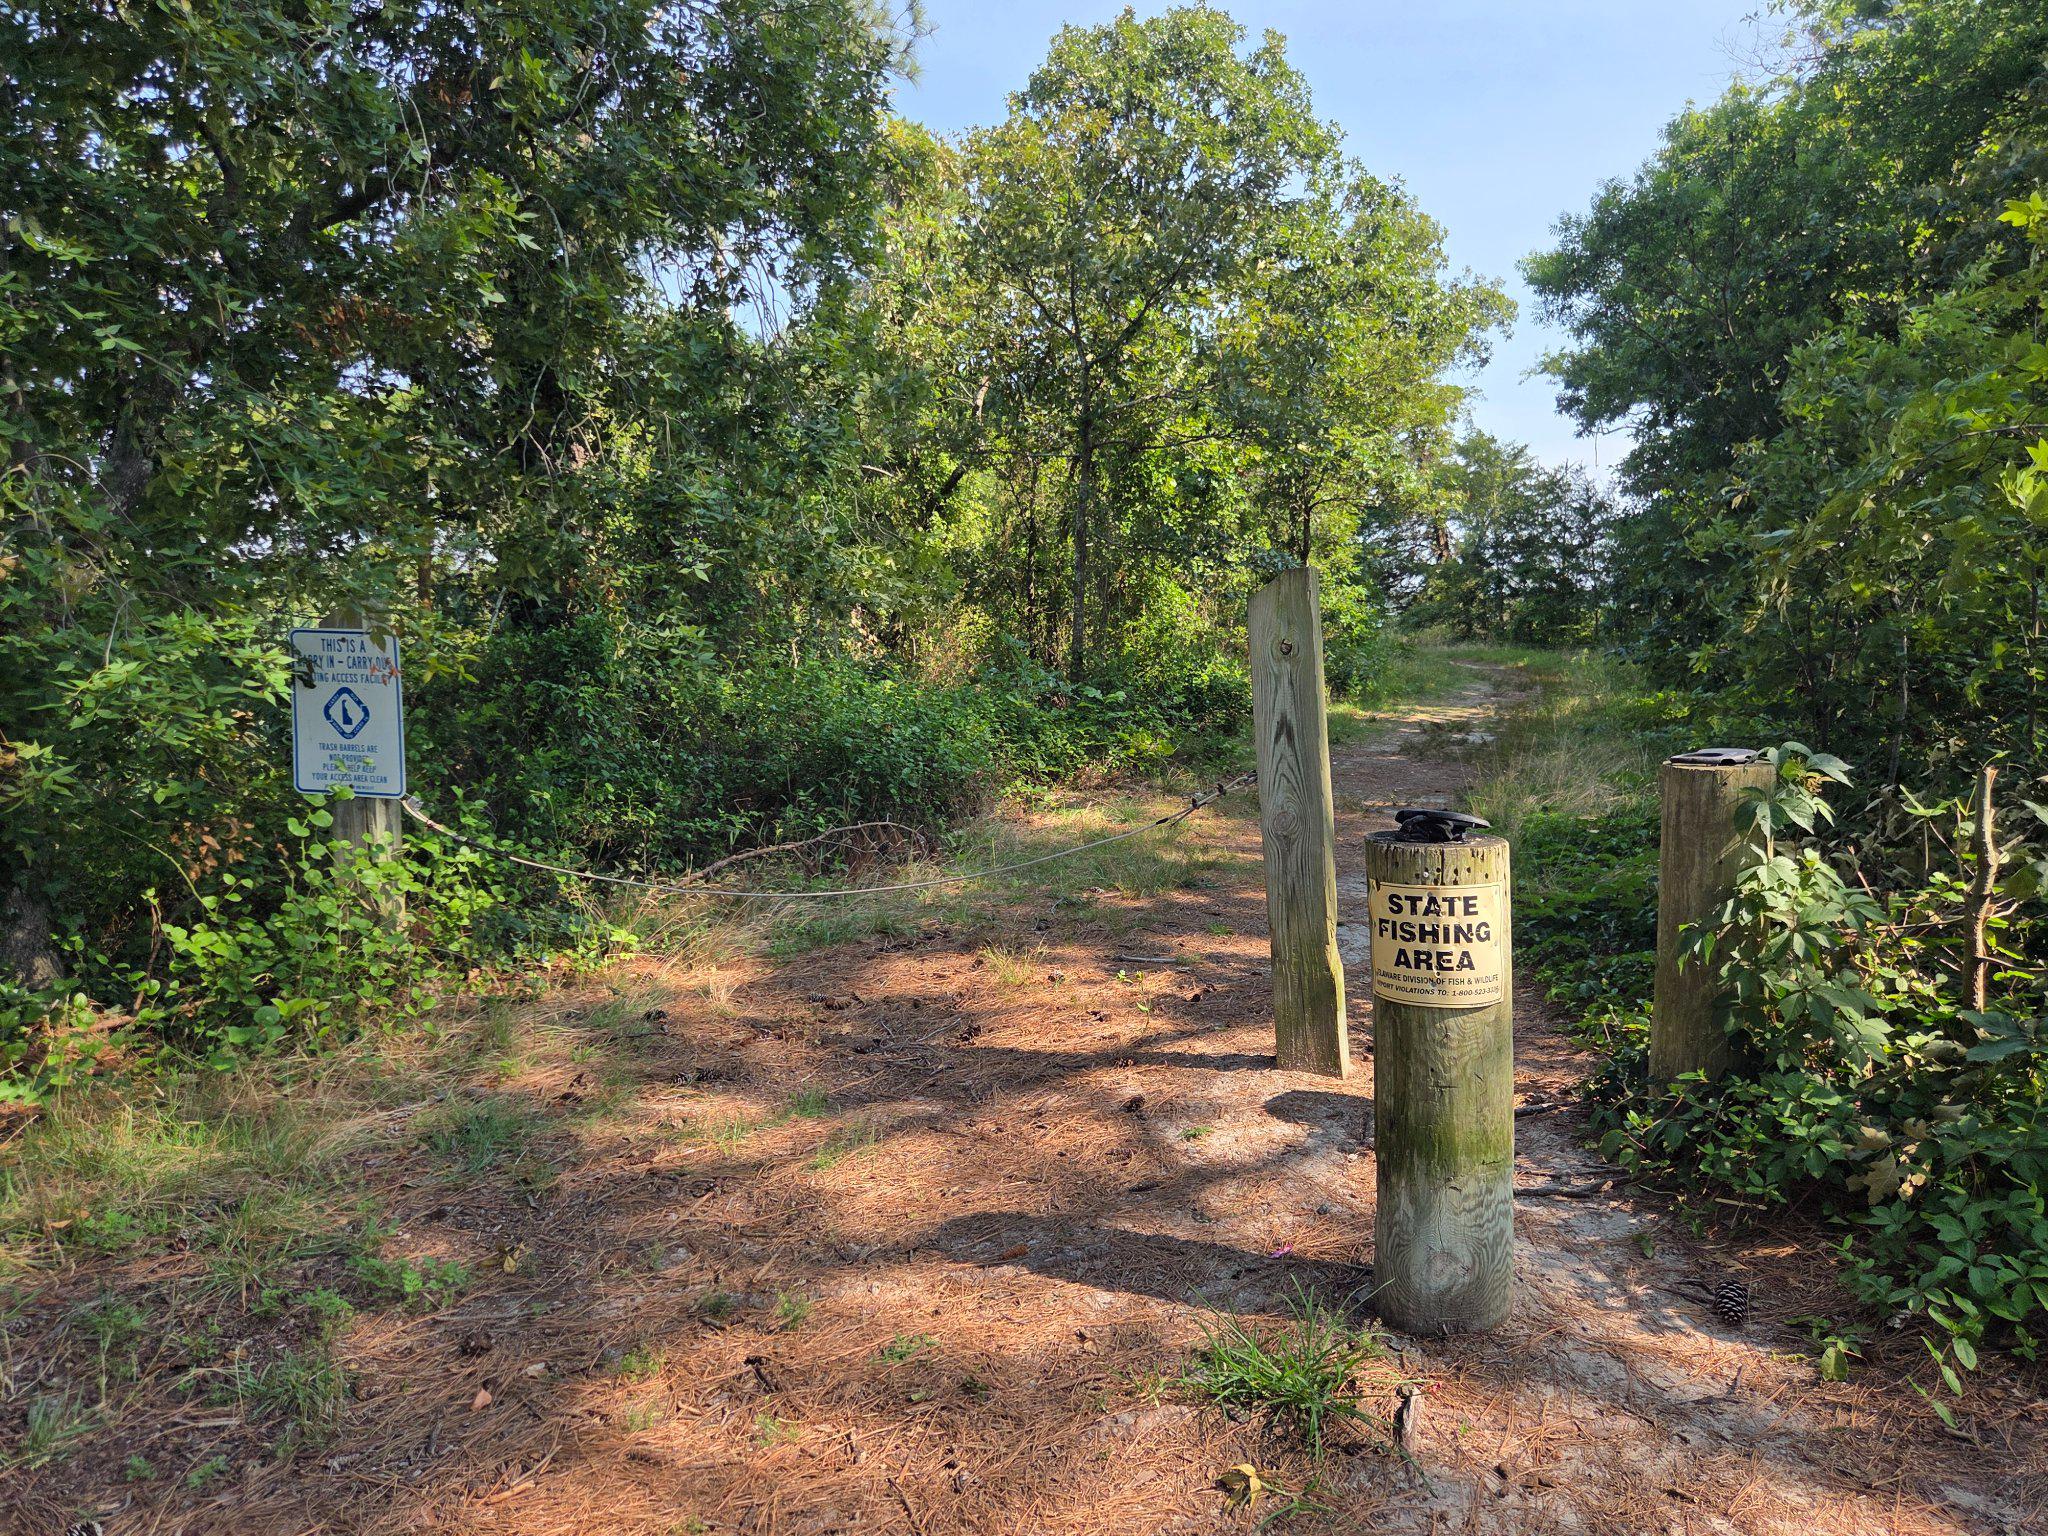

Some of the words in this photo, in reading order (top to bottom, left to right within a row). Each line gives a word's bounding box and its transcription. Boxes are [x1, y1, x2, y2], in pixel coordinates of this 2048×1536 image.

[321, 638, 340, 652] THIS
[346, 639, 356, 653] IS
[360, 640, 366, 653] A
[298, 654, 323, 668] ARRY
[326, 656, 334, 668] IN
[346, 656, 372, 669] CARRY
[376, 656, 392, 670] OU
[332, 673, 358, 683] ACCESS
[318, 743, 337, 751] TRASH
[340, 744, 364, 752] BARRELS
[367, 745, 378, 753] ARE
[362, 765, 376, 773] KEEP
[331, 773, 352, 781] ACCESS
[354, 774, 368, 782] AREA
[370, 775, 388, 784] CLEAN
[1388, 894, 1478, 917] STATE
[1378, 918, 1491, 944] FISHING
[1394, 948, 1475, 972] AREA
[1403, 974, 1435, 984] DIVISION
[1475, 974, 1499, 984] WILDLIFE
[1394, 985, 1435, 996] VIOLATIONS
